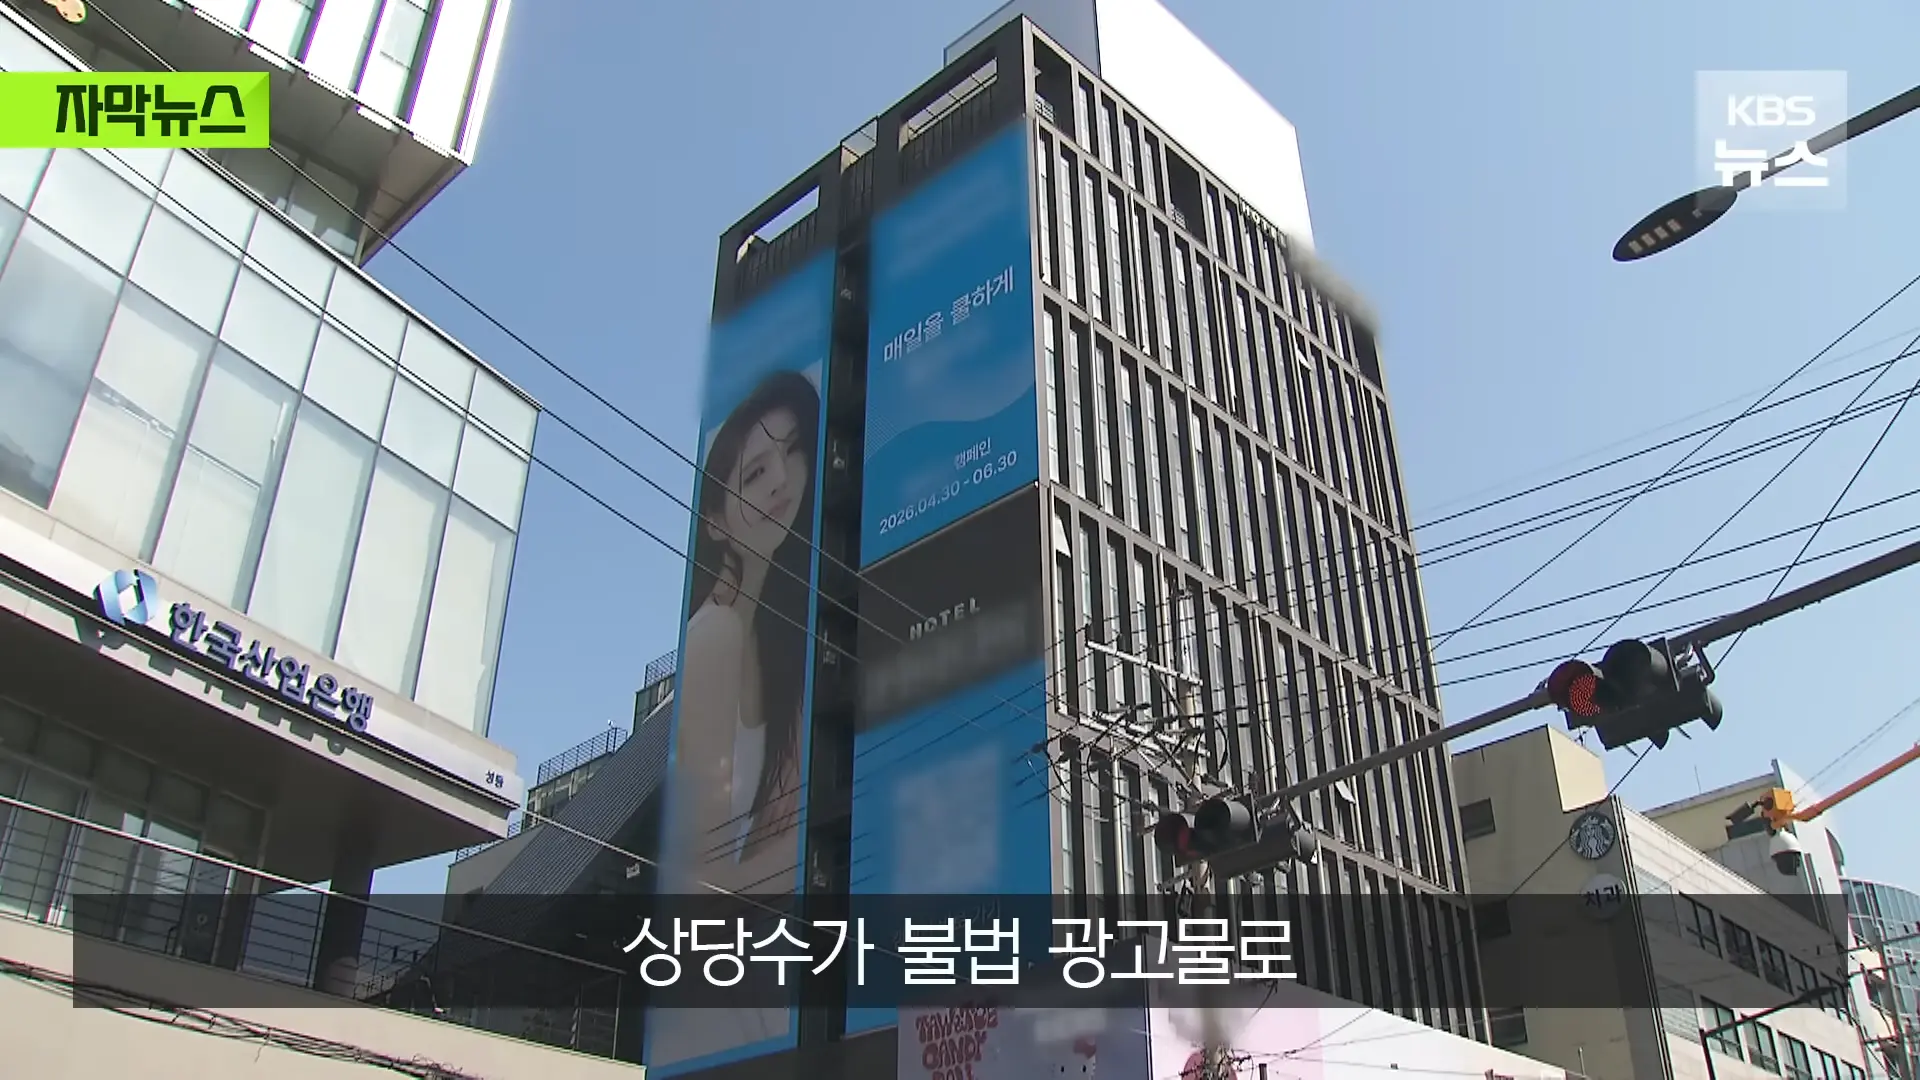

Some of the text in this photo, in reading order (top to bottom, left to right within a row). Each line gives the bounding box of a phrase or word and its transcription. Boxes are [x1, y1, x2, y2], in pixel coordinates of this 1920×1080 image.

[883, 264, 1014, 362] 매일을 쿨하게
[169, 602, 374, 732] 한국산업은행
[909, 597, 980, 641] HOTEL
